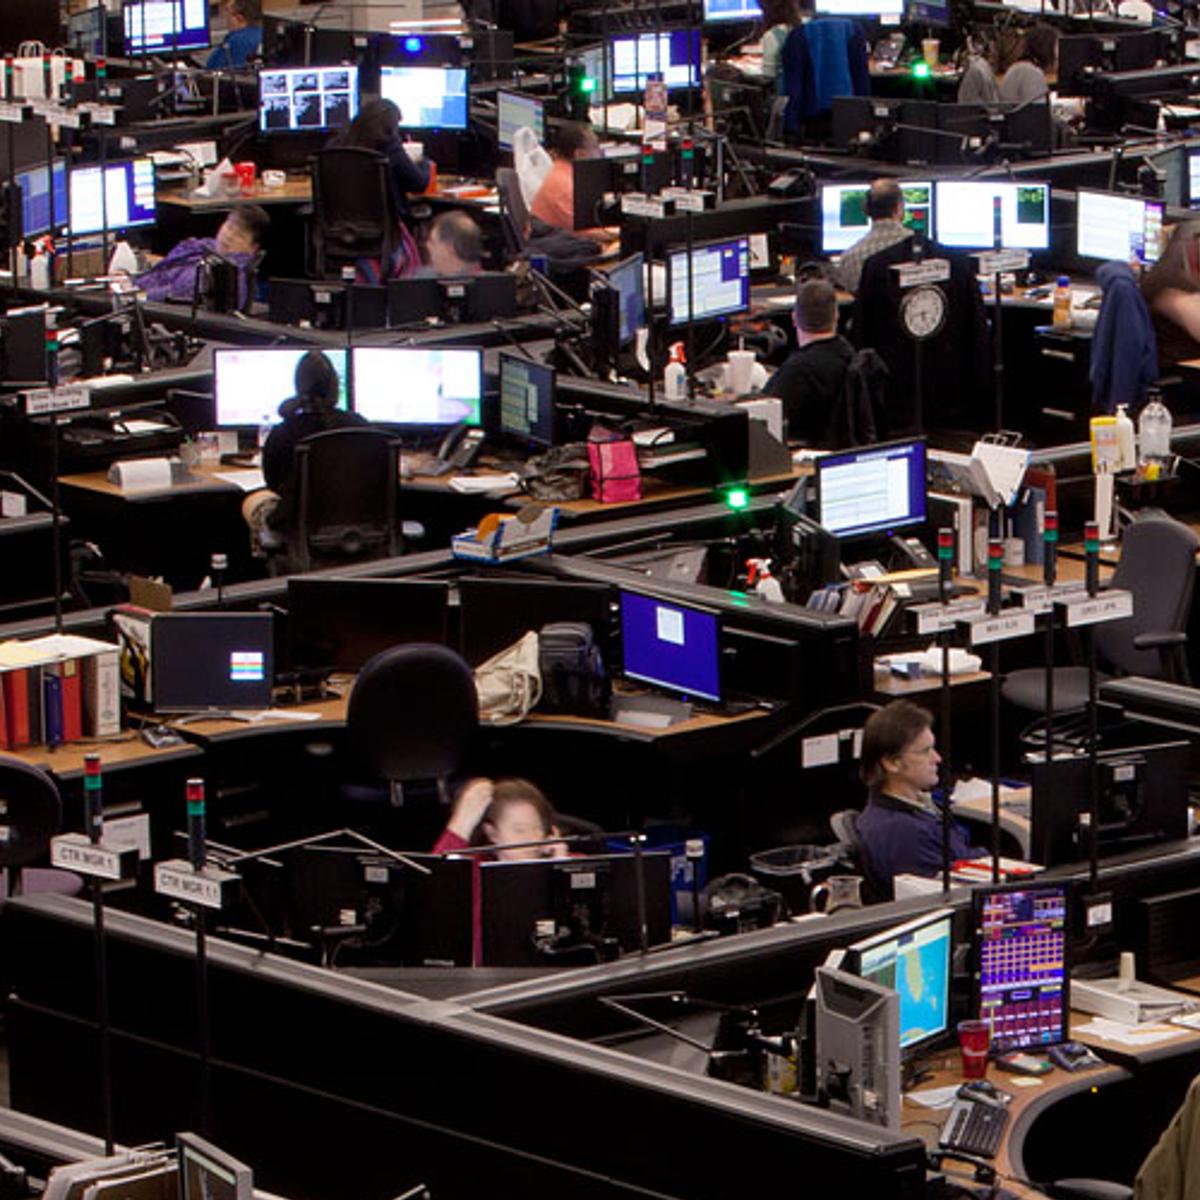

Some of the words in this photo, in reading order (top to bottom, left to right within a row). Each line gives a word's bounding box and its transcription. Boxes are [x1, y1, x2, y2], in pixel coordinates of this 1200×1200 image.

[60, 846, 80, 862] CTR
[83, 852, 105, 868] MGR
[160, 873, 179, 889] CTR
[182, 879, 202, 894] MGR
